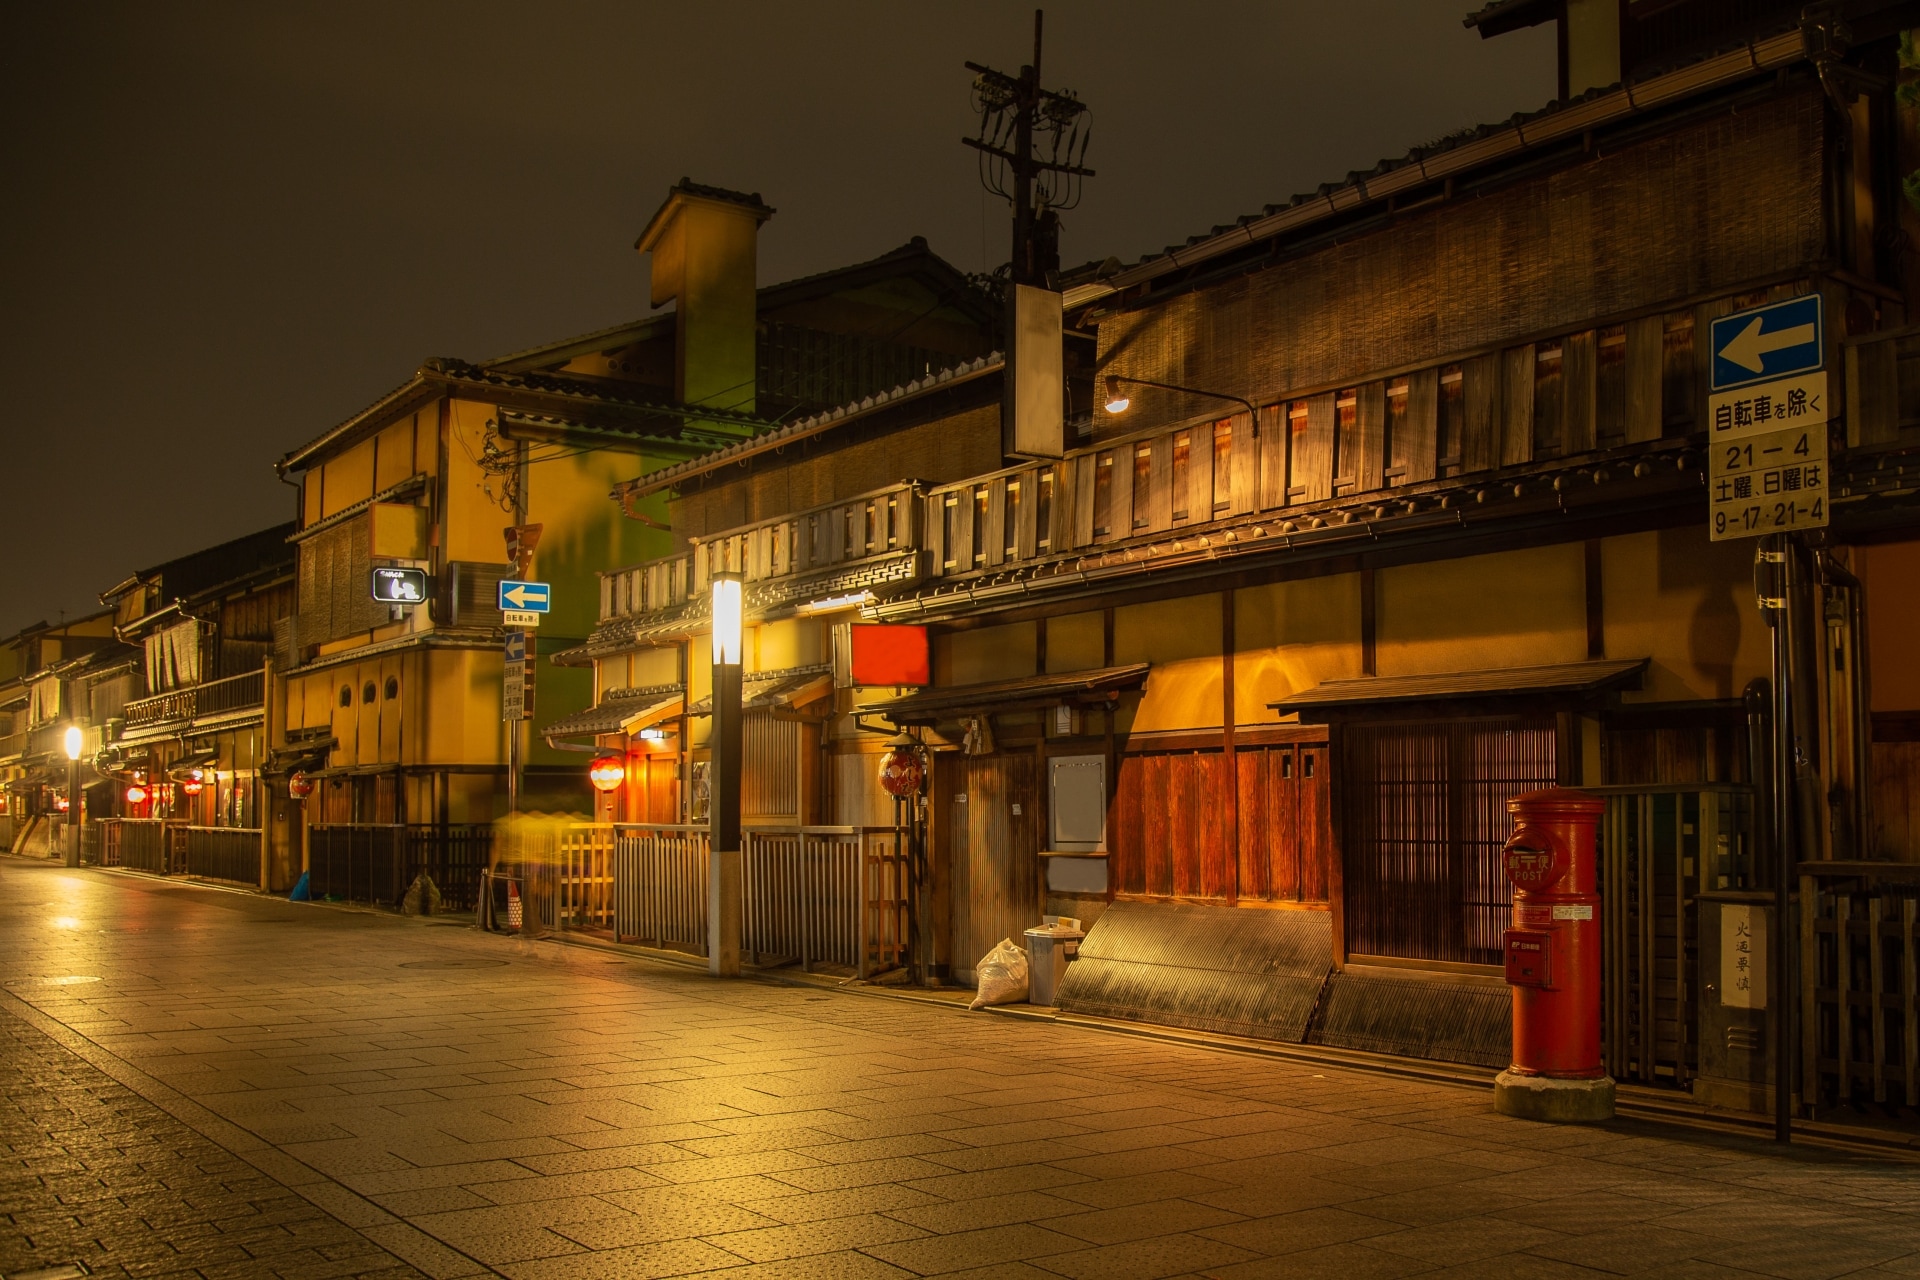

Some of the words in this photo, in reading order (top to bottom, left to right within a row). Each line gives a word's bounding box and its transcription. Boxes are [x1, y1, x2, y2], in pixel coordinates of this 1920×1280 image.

[1715, 387, 1821, 432] 自転車を除く
[1715, 465, 1821, 503] 土曜、日曜は
[1515, 871, 1543, 882] POST
